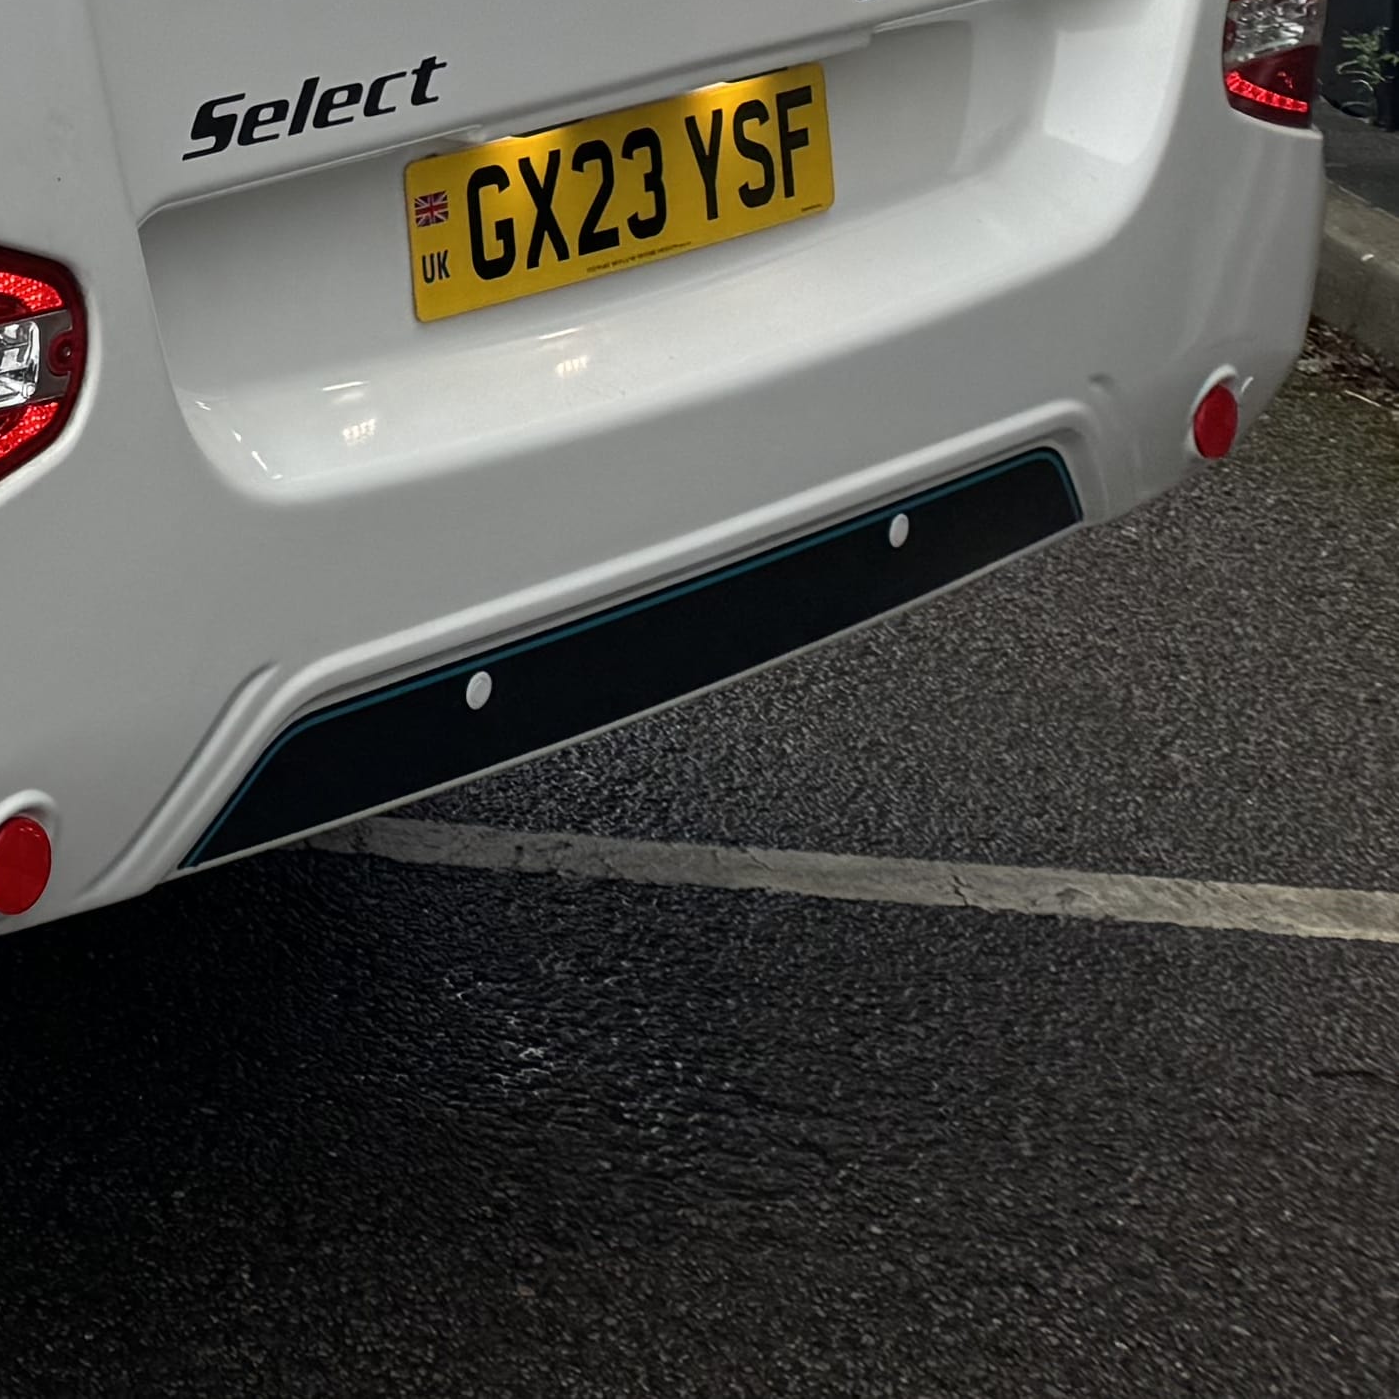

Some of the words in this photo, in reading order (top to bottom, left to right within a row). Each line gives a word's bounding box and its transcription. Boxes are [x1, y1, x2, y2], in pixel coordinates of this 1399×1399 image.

[182, 55, 448, 162] Select
[465, 126, 666, 281] GX23
[684, 85, 814, 220] YSF
[422, 249, 451, 284] UK
